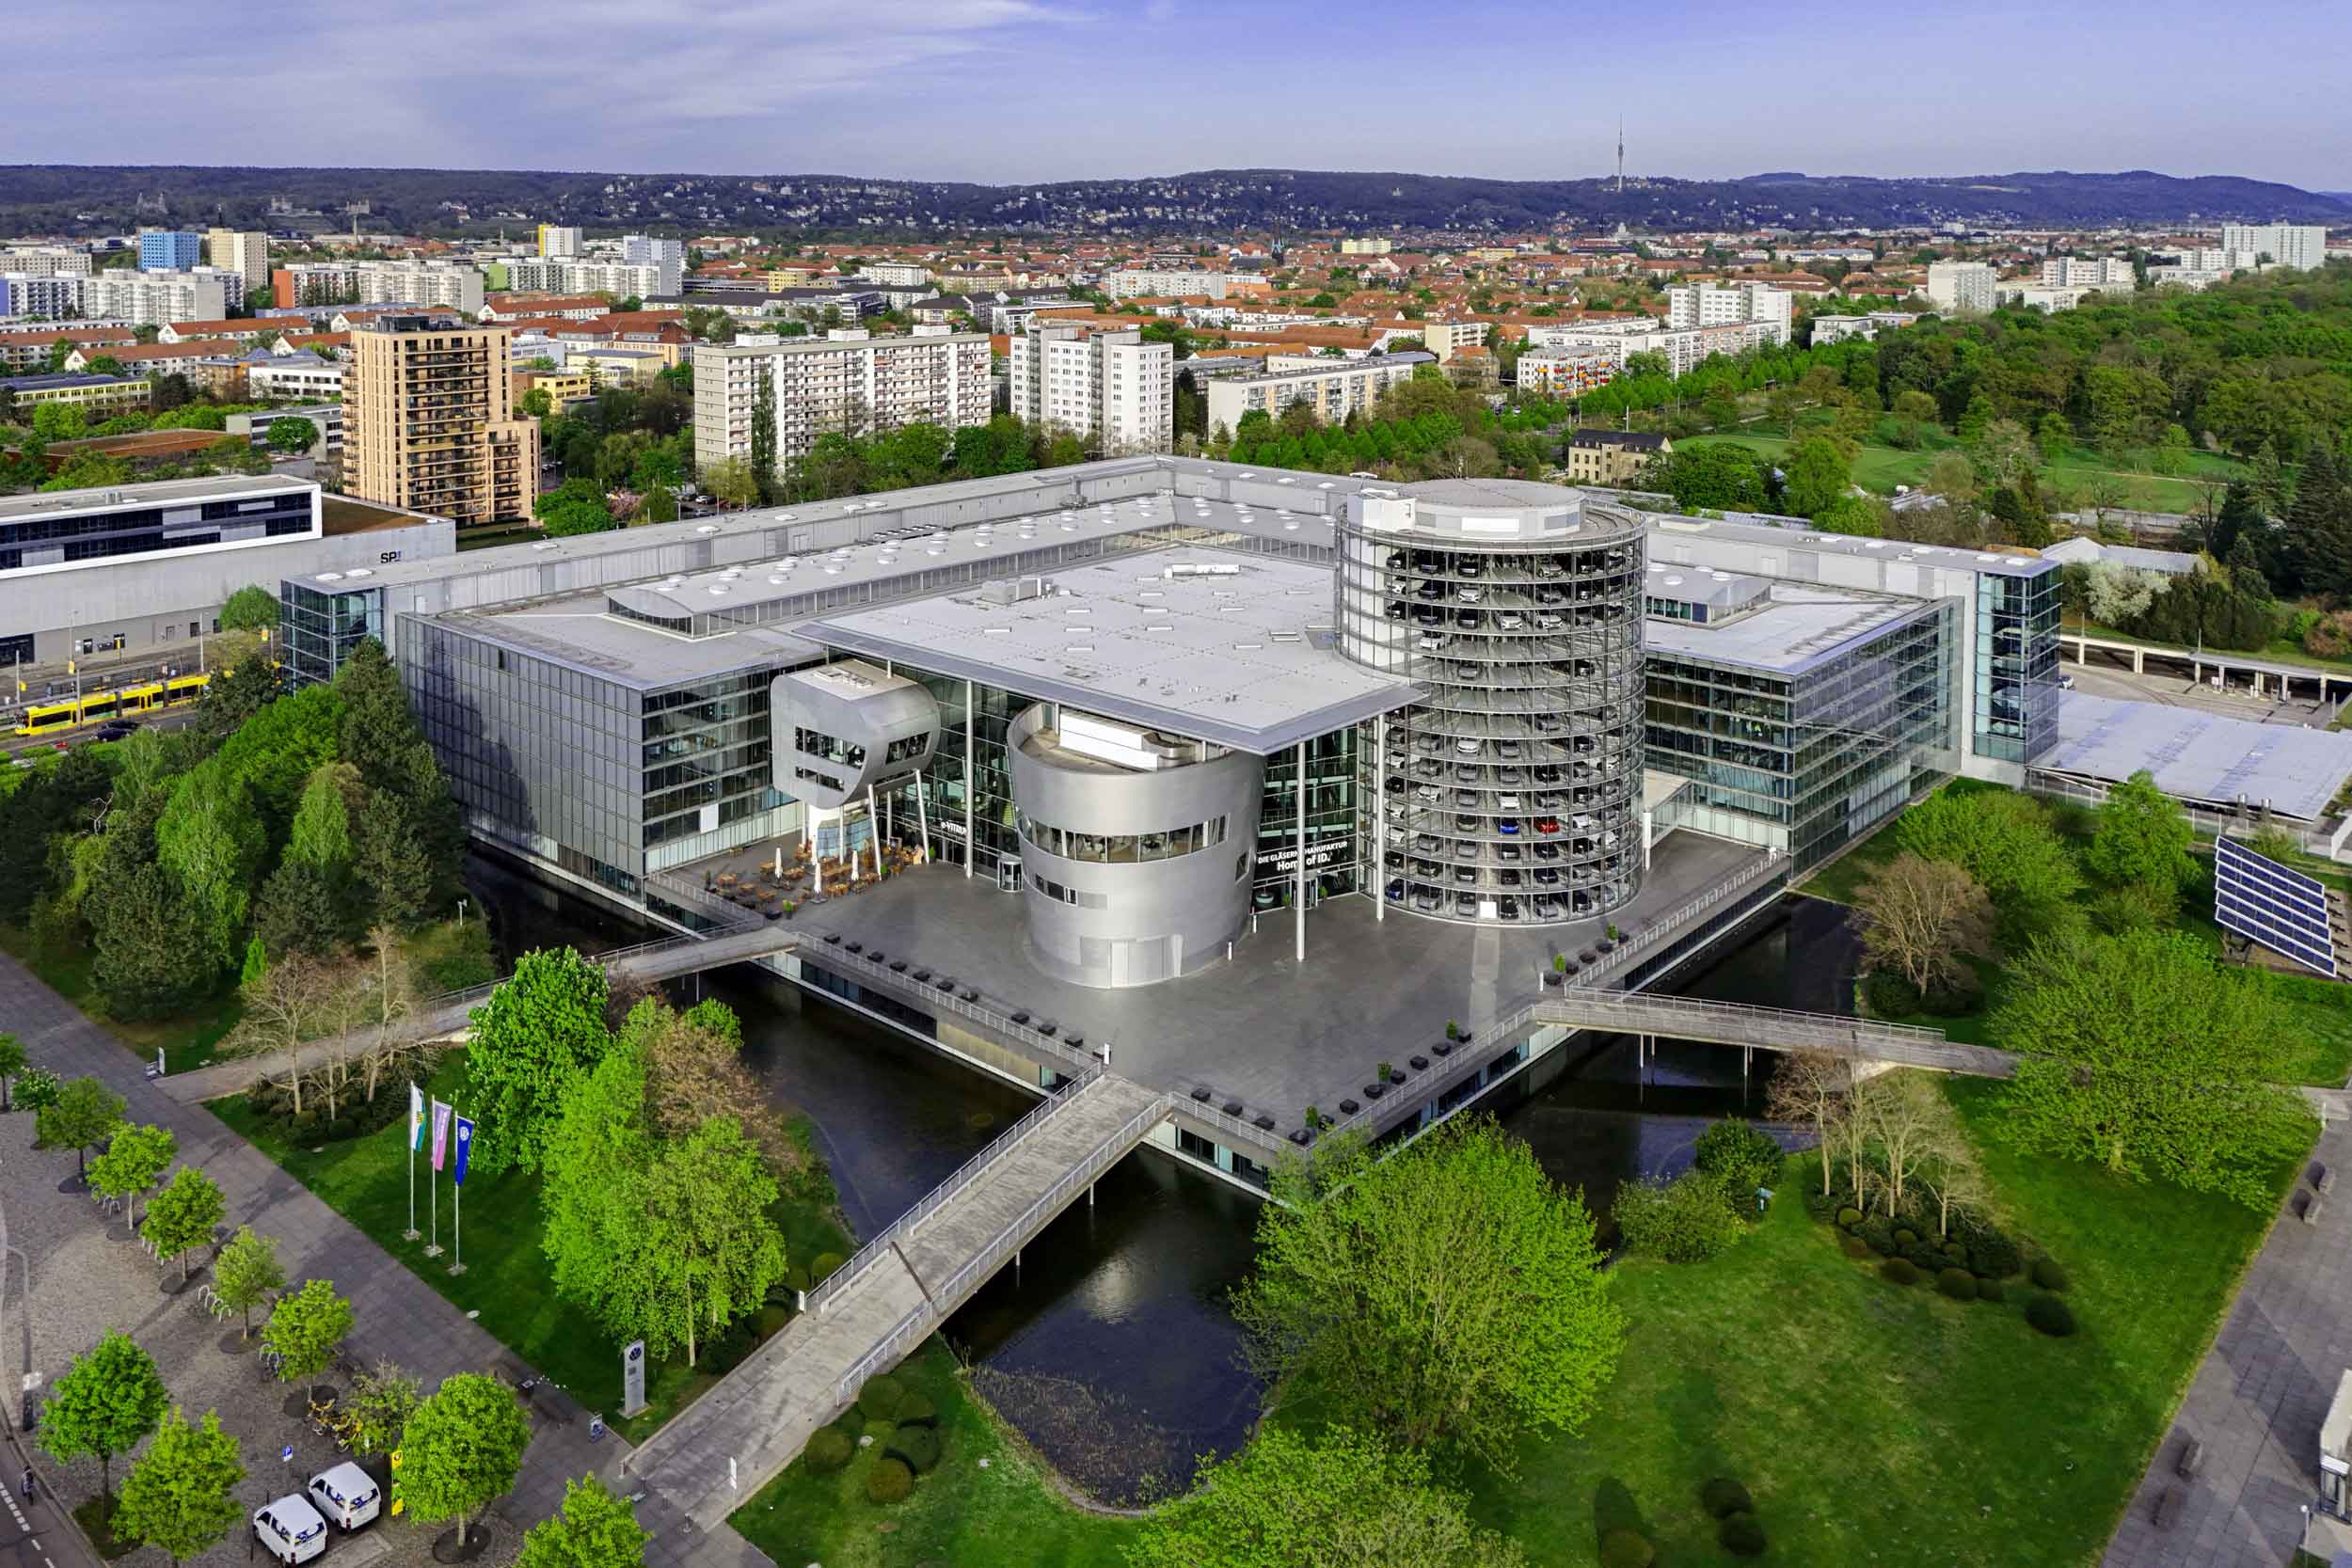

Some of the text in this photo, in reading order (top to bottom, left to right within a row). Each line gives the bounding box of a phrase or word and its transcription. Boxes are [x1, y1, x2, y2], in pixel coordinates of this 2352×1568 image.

[1258, 855, 1269, 864] DIE
[1270, 850, 1299, 862] GLÄSERN
[1277, 860, 1298, 871] Hom
[1306, 854, 1316, 866] of
